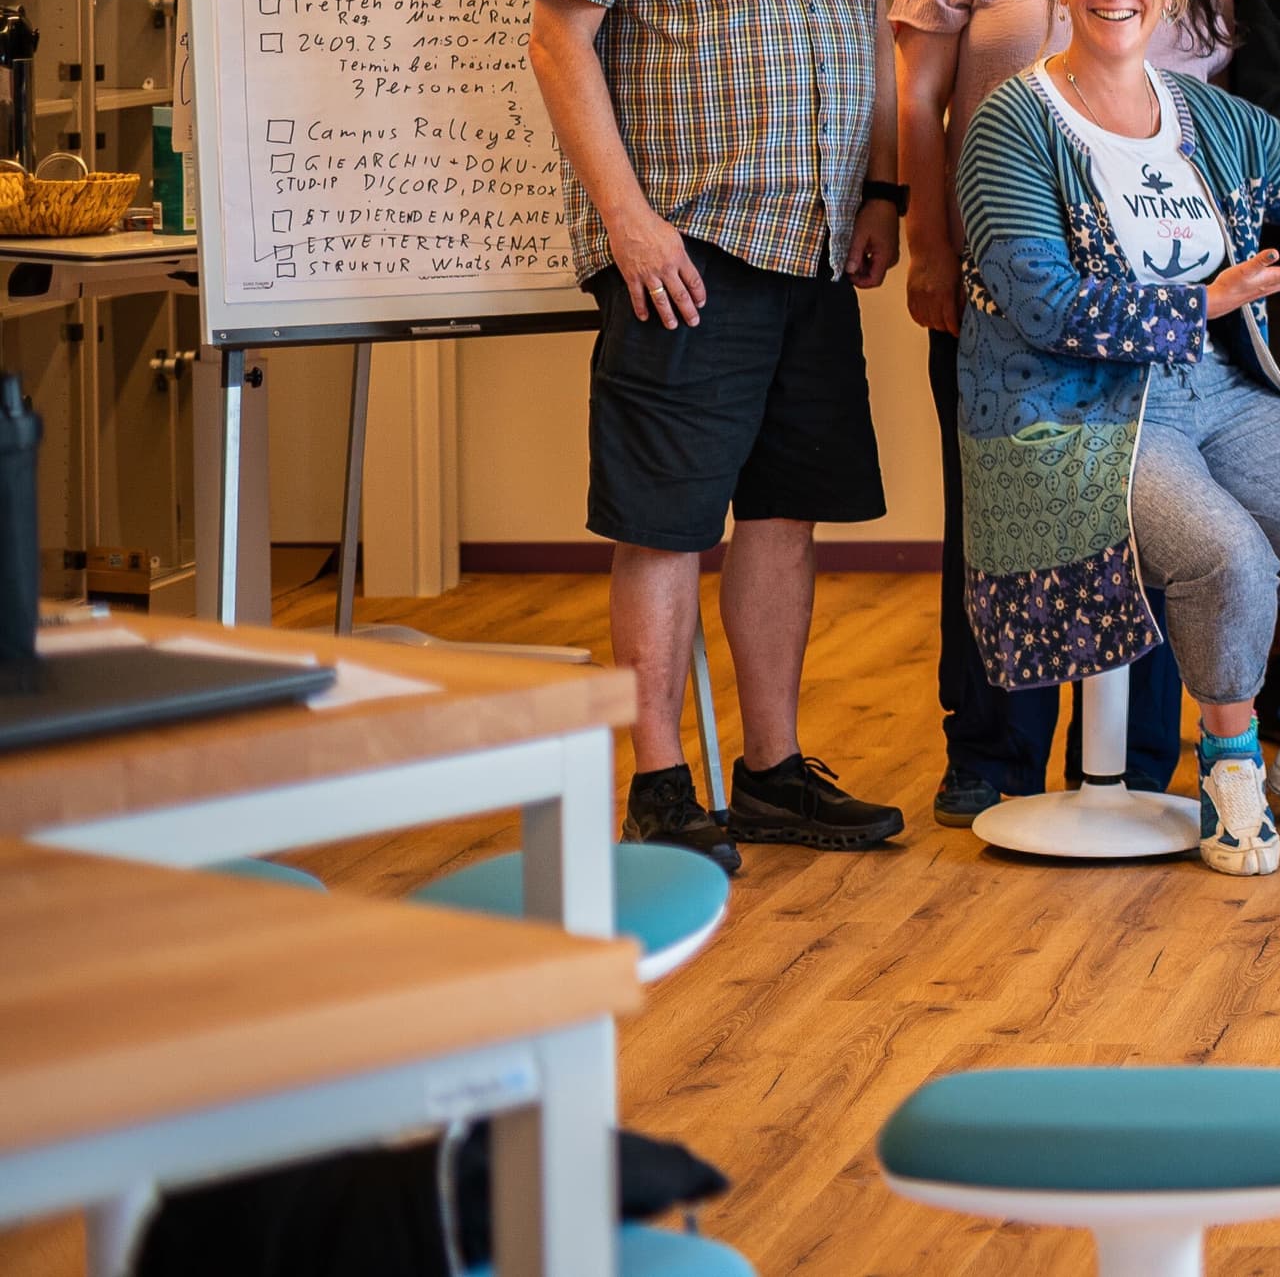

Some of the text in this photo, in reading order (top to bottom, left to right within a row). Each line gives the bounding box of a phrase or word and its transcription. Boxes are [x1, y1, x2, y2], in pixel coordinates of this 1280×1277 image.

[339, 54, 527, 72] Termin bei Präsident
[352, 78, 365, 98] 3
[308, 121, 397, 144] Campus
[472, 178, 557, 197] DROPBOX
[1122, 194, 1212, 220] VITAMIN
[1157, 218, 1193, 240] Sea
[484, 235, 552, 254] SENAT
[310, 257, 411, 276] STRUKTUR
[432, 254, 491, 272] Whats
[501, 254, 538, 268] APP
